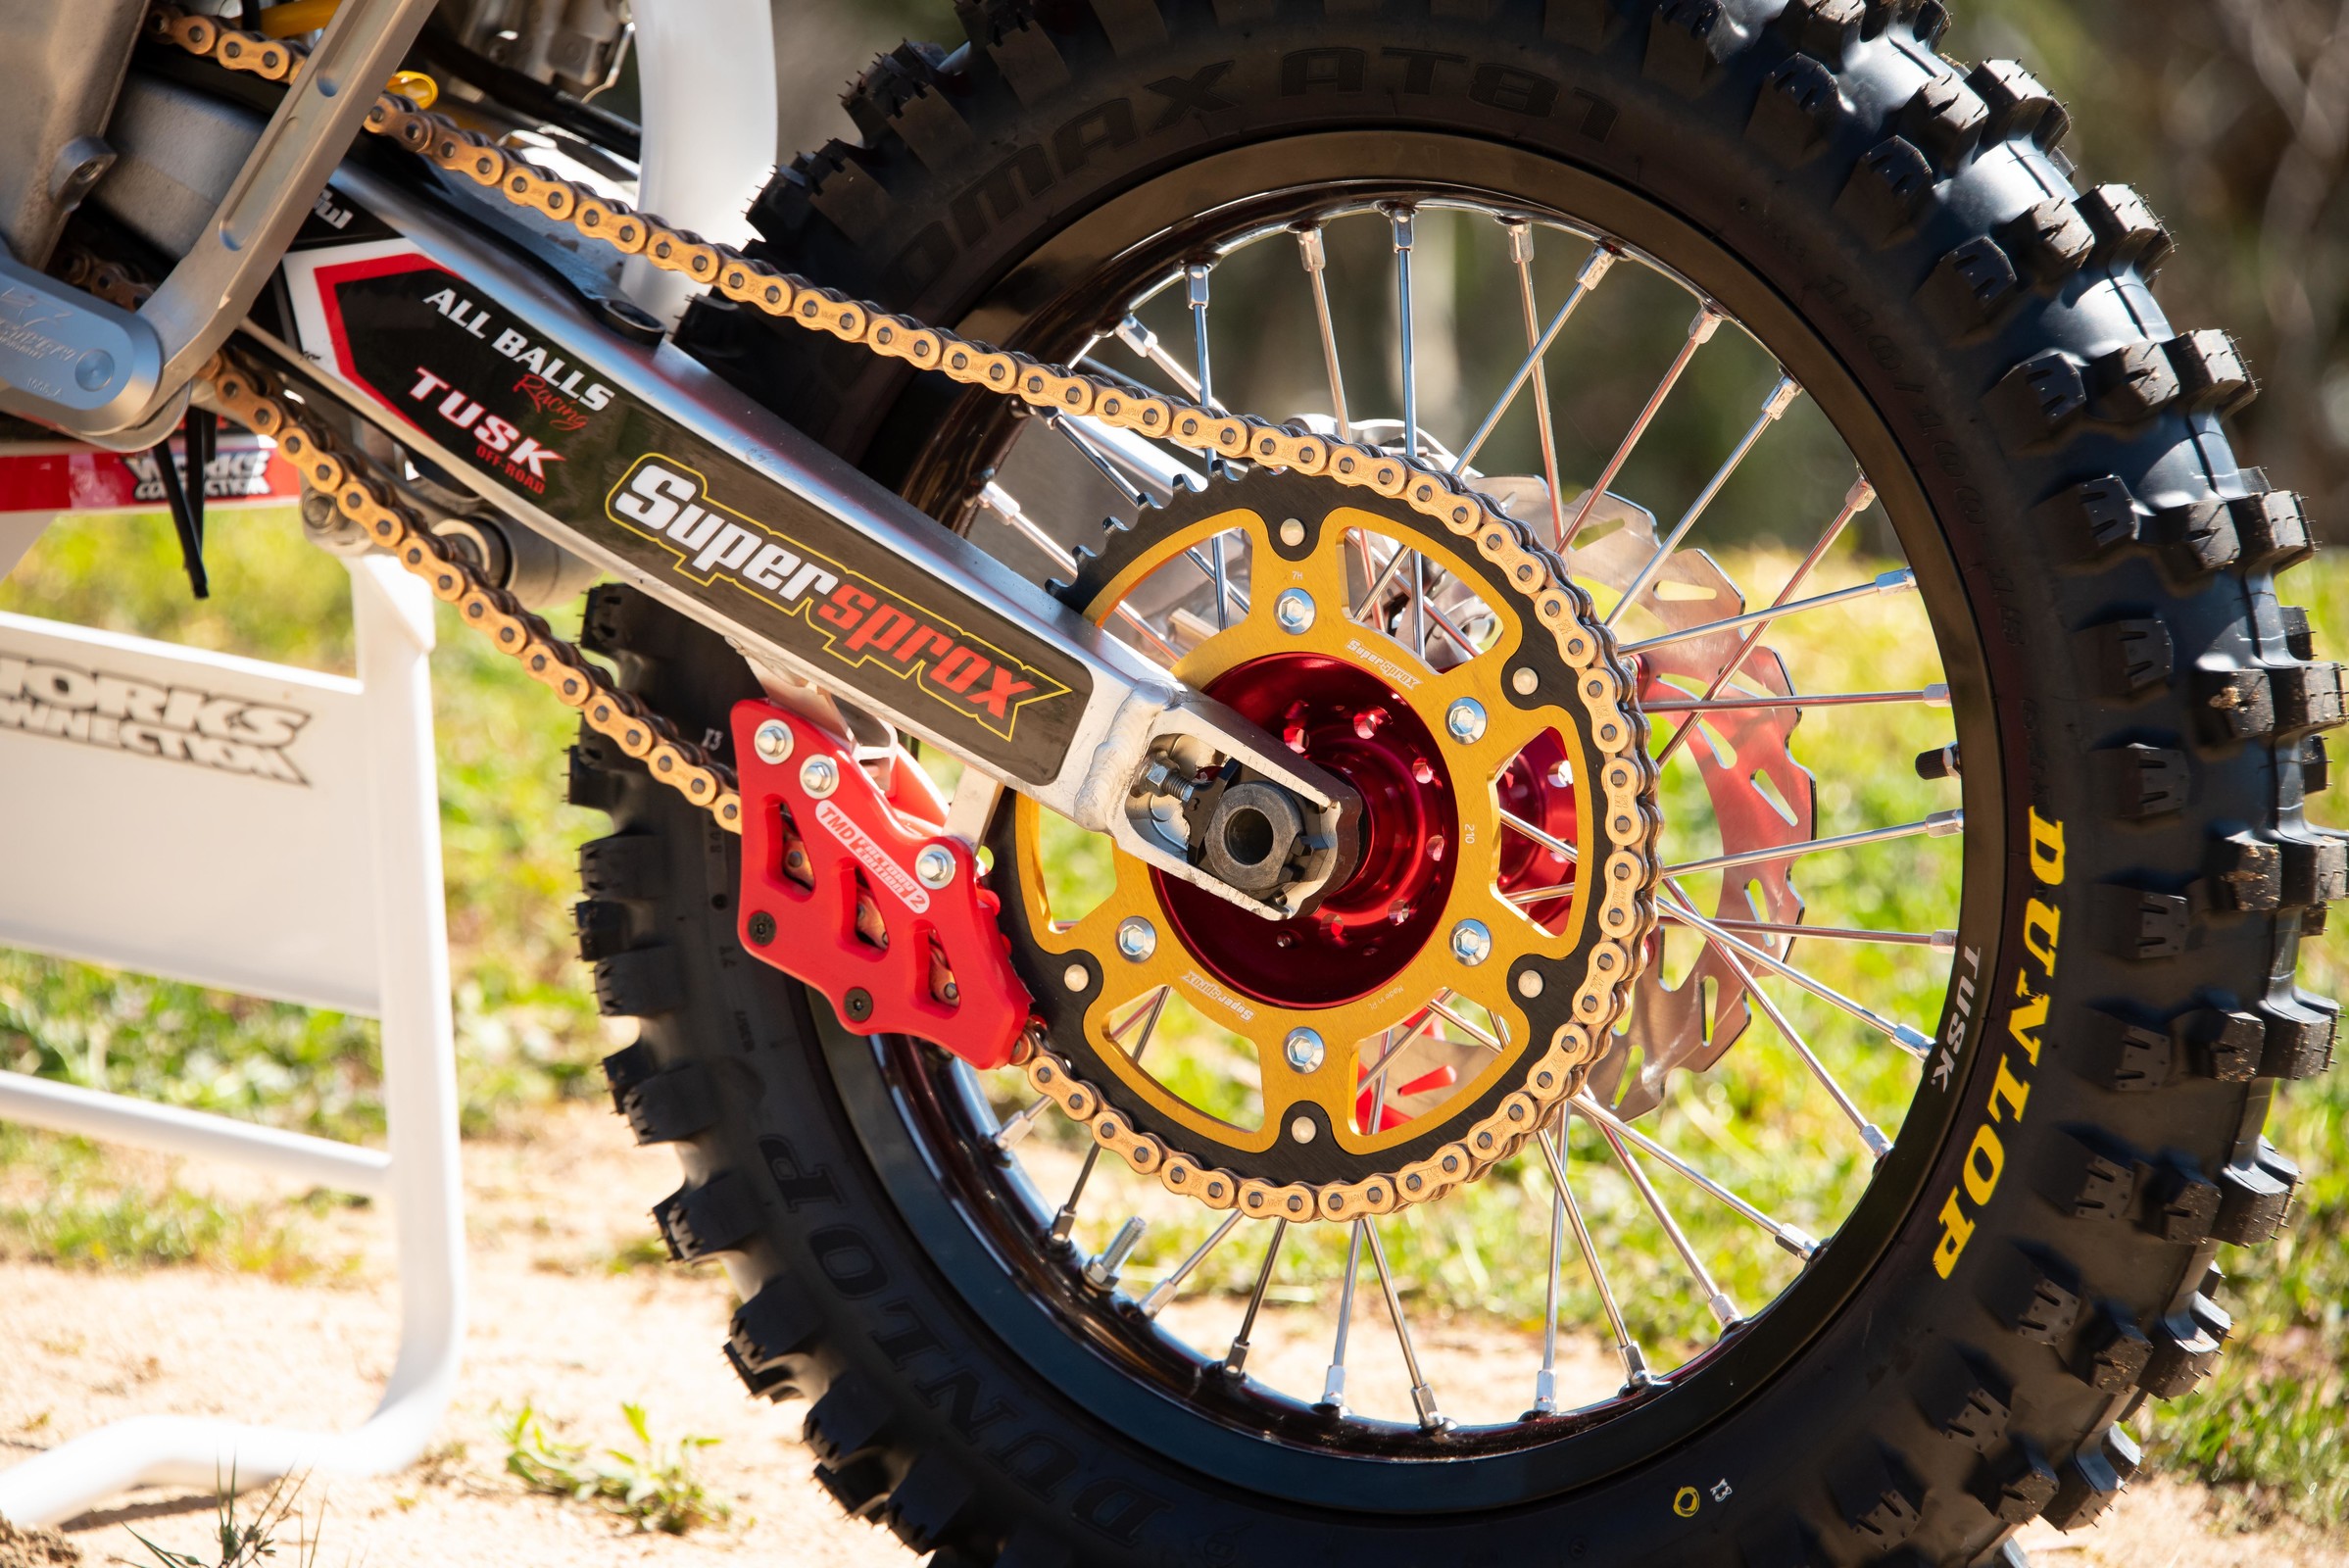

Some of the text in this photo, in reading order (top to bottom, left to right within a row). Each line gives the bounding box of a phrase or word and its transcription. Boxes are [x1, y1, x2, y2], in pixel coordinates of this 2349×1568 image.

[422, 287, 616, 412] ALL BALLS
[409, 366, 566, 481] TUSK
[513, 373, 589, 431] Racing
[475, 443, 547, 495] OFF-ROAD
[1292, 570, 1304, 581] 7H
[0, 694, 312, 788] NNECTION
[820, 807, 856, 840] TMD
[1464, 823, 1476, 845] 210
[855, 847, 906, 896] EDITION
[857, 837, 915, 892] FACTORY
[909, 895, 927, 909] 2
[1932, 805, 2065, 1280] DUNLOP
[1933, 945, 1981, 1094] TUSK
[758, 1133, 1175, 1548] DUNLOP
